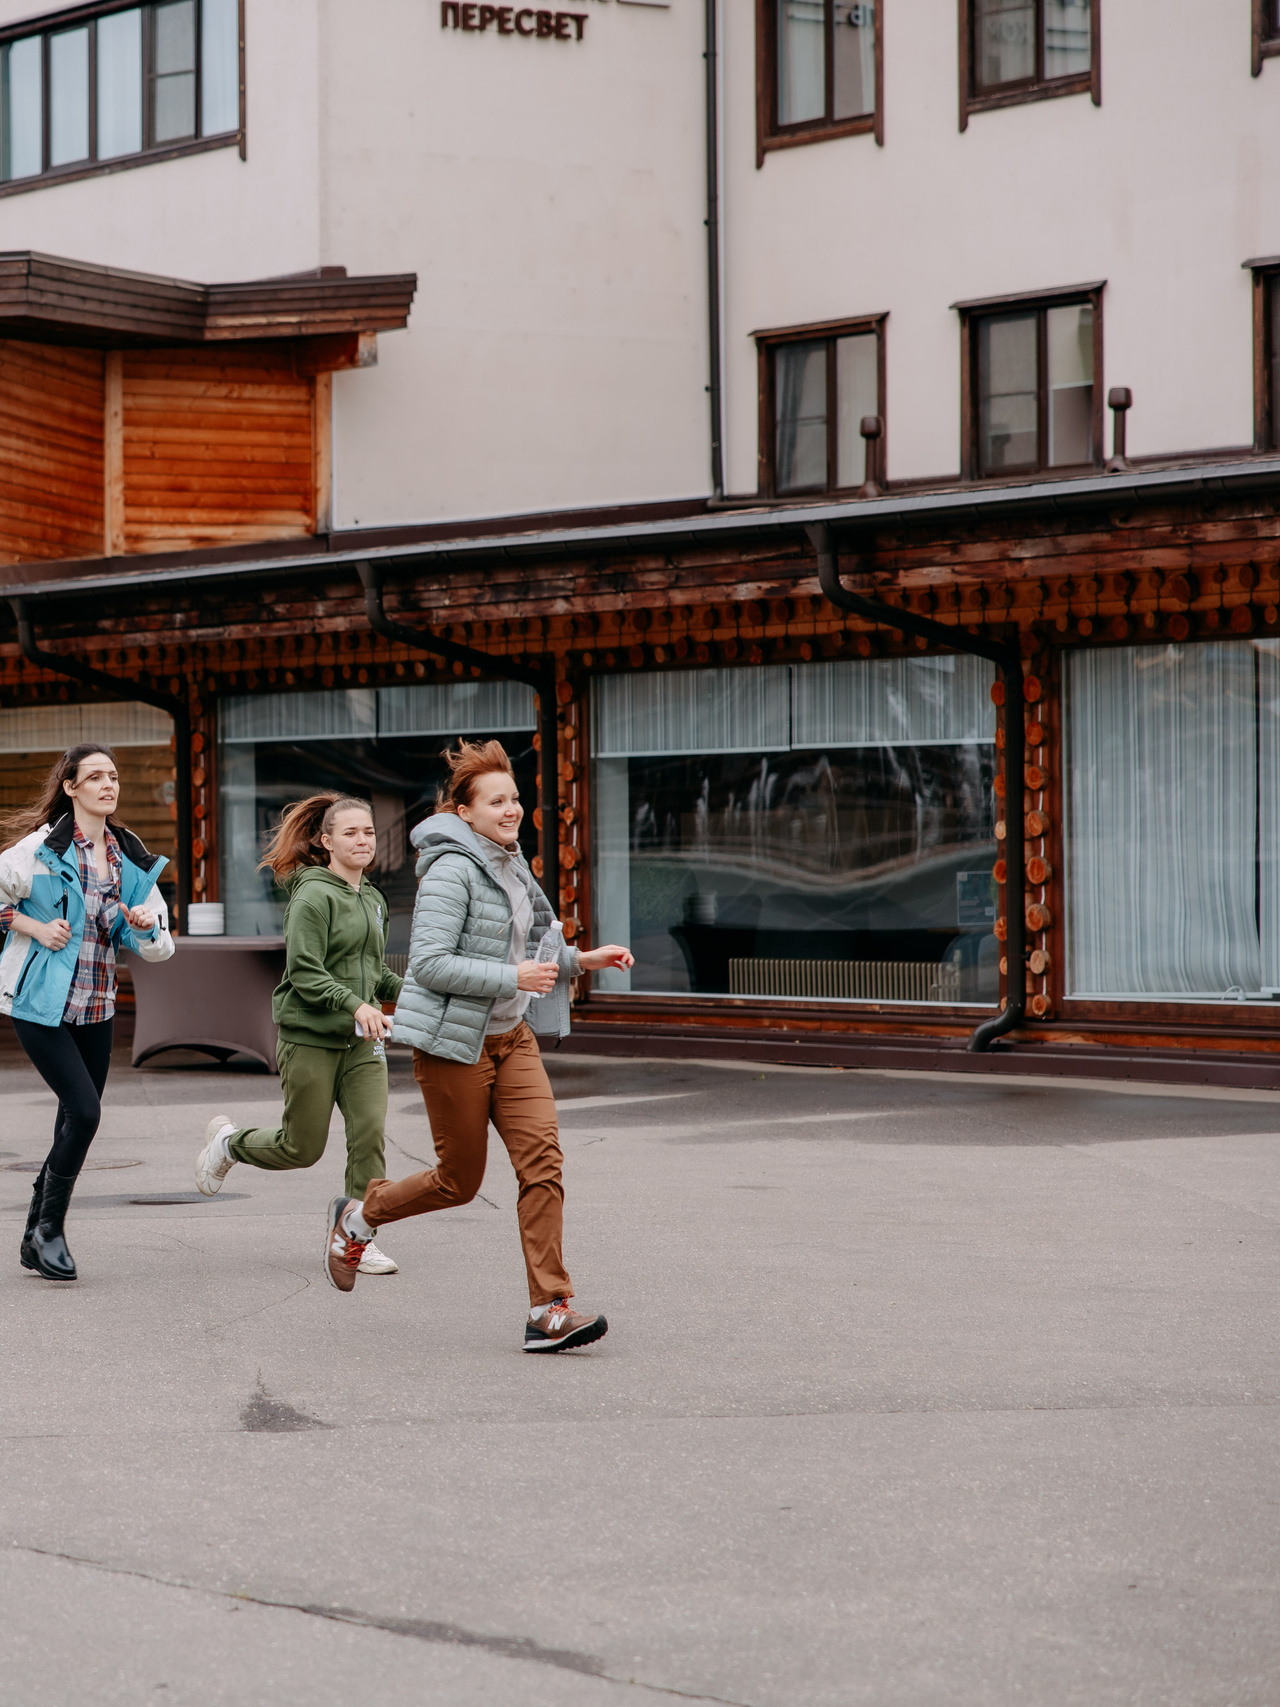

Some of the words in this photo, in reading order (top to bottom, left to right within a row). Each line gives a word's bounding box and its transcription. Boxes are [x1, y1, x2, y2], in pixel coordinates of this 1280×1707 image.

[441, 1, 588, 40] ПЕРЕСВЕТ
[332, 1233, 346, 1256] N
[548, 1314, 566, 1331] N
